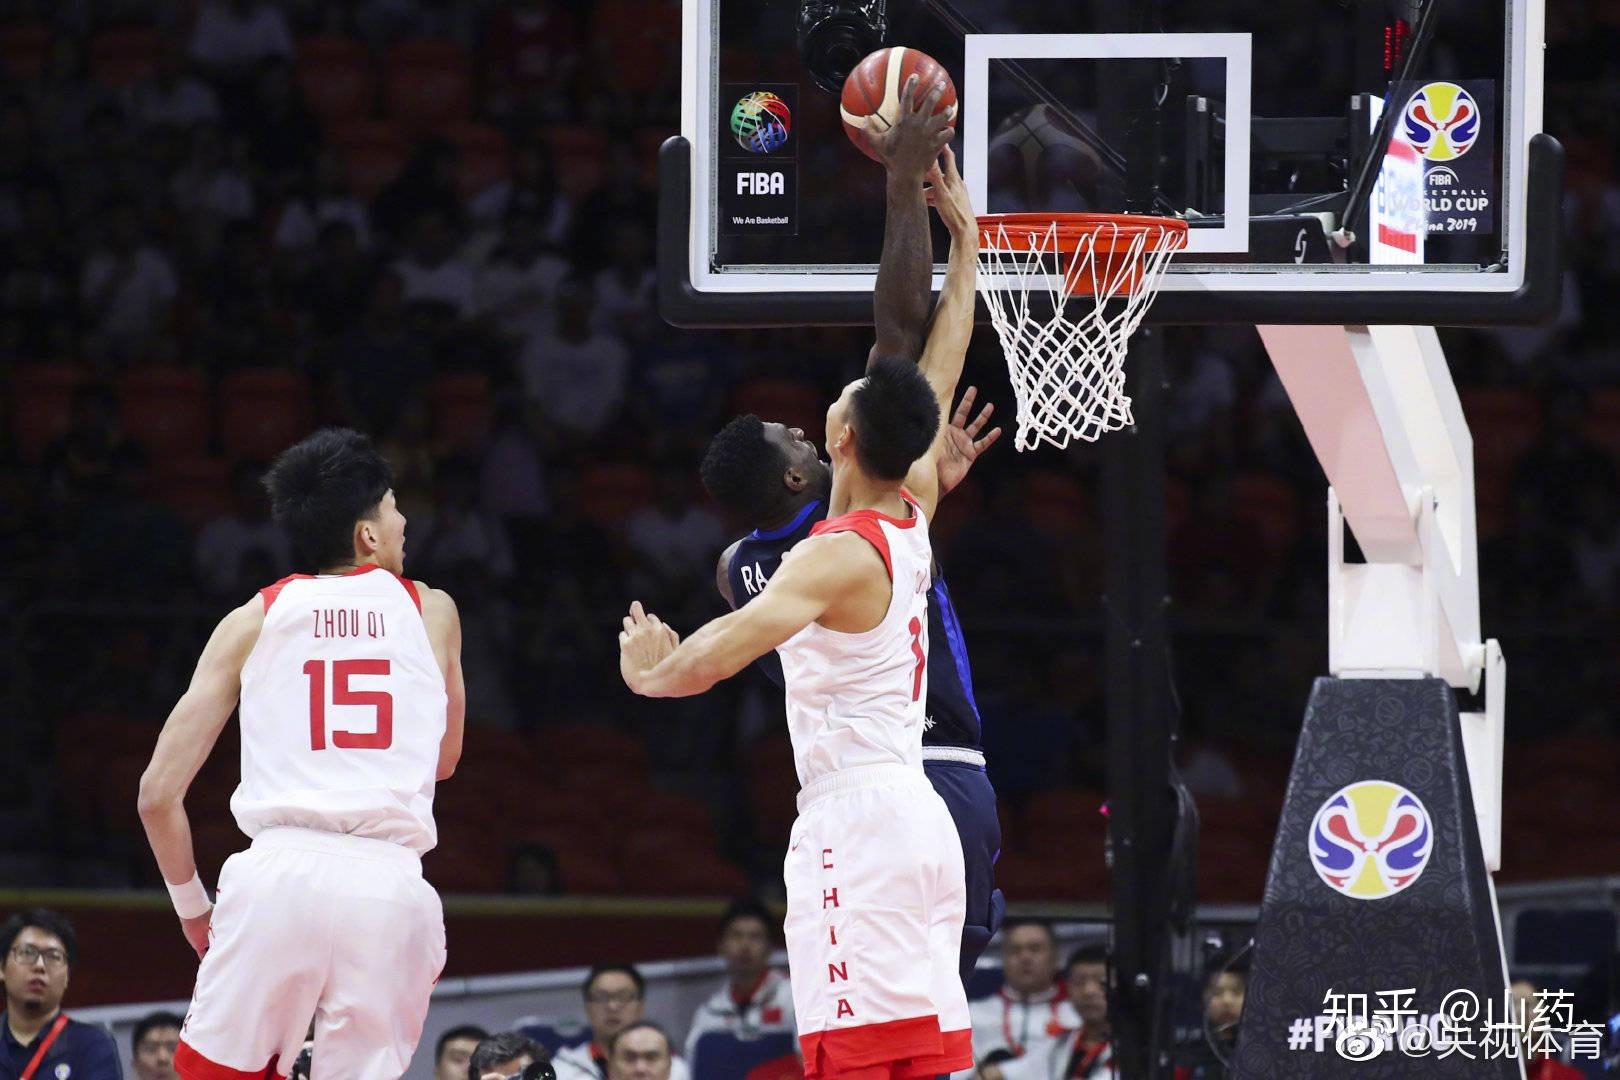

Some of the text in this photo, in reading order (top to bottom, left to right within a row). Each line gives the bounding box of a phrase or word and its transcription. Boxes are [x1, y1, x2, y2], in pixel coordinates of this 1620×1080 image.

[737, 172, 784, 194] FIBA
[1429, 174, 1452, 186] FIBA
[1455, 197, 1489, 212] CUP
[732, 216, 789, 224] We Are Basketball
[1447, 217, 1477, 232] 2019
[313, 609, 385, 639] ZHOU QI
[303, 659, 393, 751] 15
[822, 848, 855, 1019] CHINA
